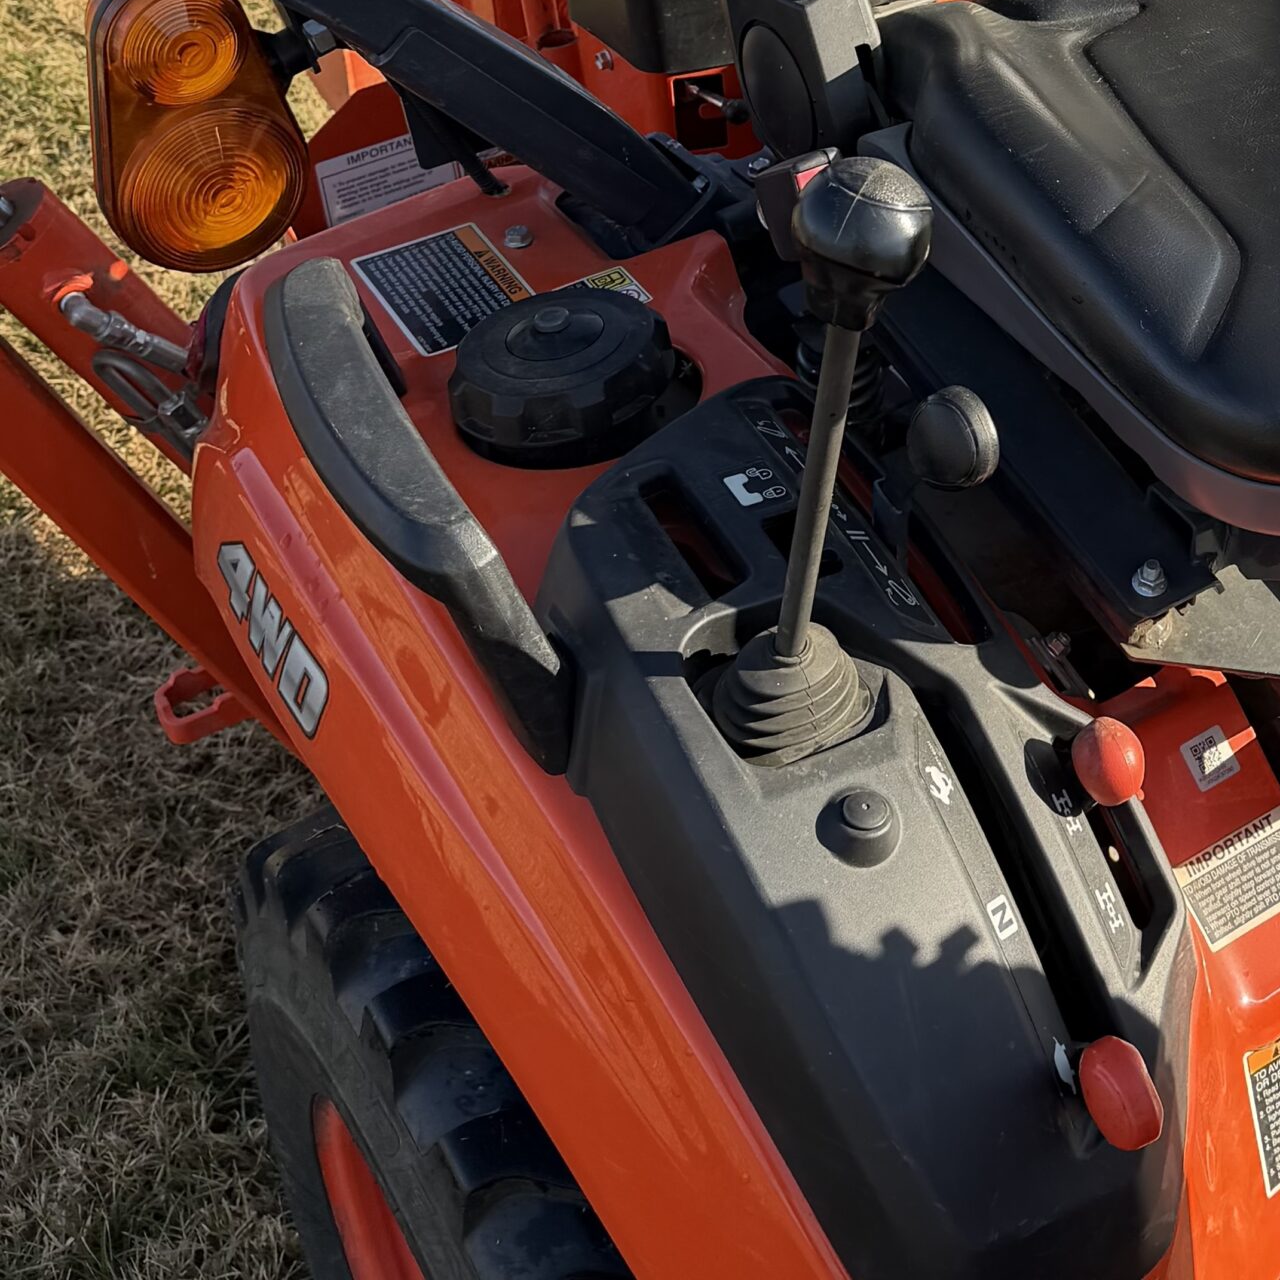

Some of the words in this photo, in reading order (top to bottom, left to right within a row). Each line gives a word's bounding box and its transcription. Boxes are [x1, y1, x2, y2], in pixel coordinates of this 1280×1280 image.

[347, 137, 413, 165] IMPORTAN
[483, 255, 523, 296] WARNING
[217, 541, 330, 740] 4WD
[1183, 813, 1277, 877] IMPORTANT
[1183, 884, 1194, 895] TO
[1191, 873, 1212, 890] AVOID
[1210, 857, 1238, 879] DAMAGE
[1236, 851, 1248, 863] OF
[991, 902, 1014, 933] N
[1254, 1067, 1266, 1082] TO
[1255, 1076, 1269, 1092] OR
